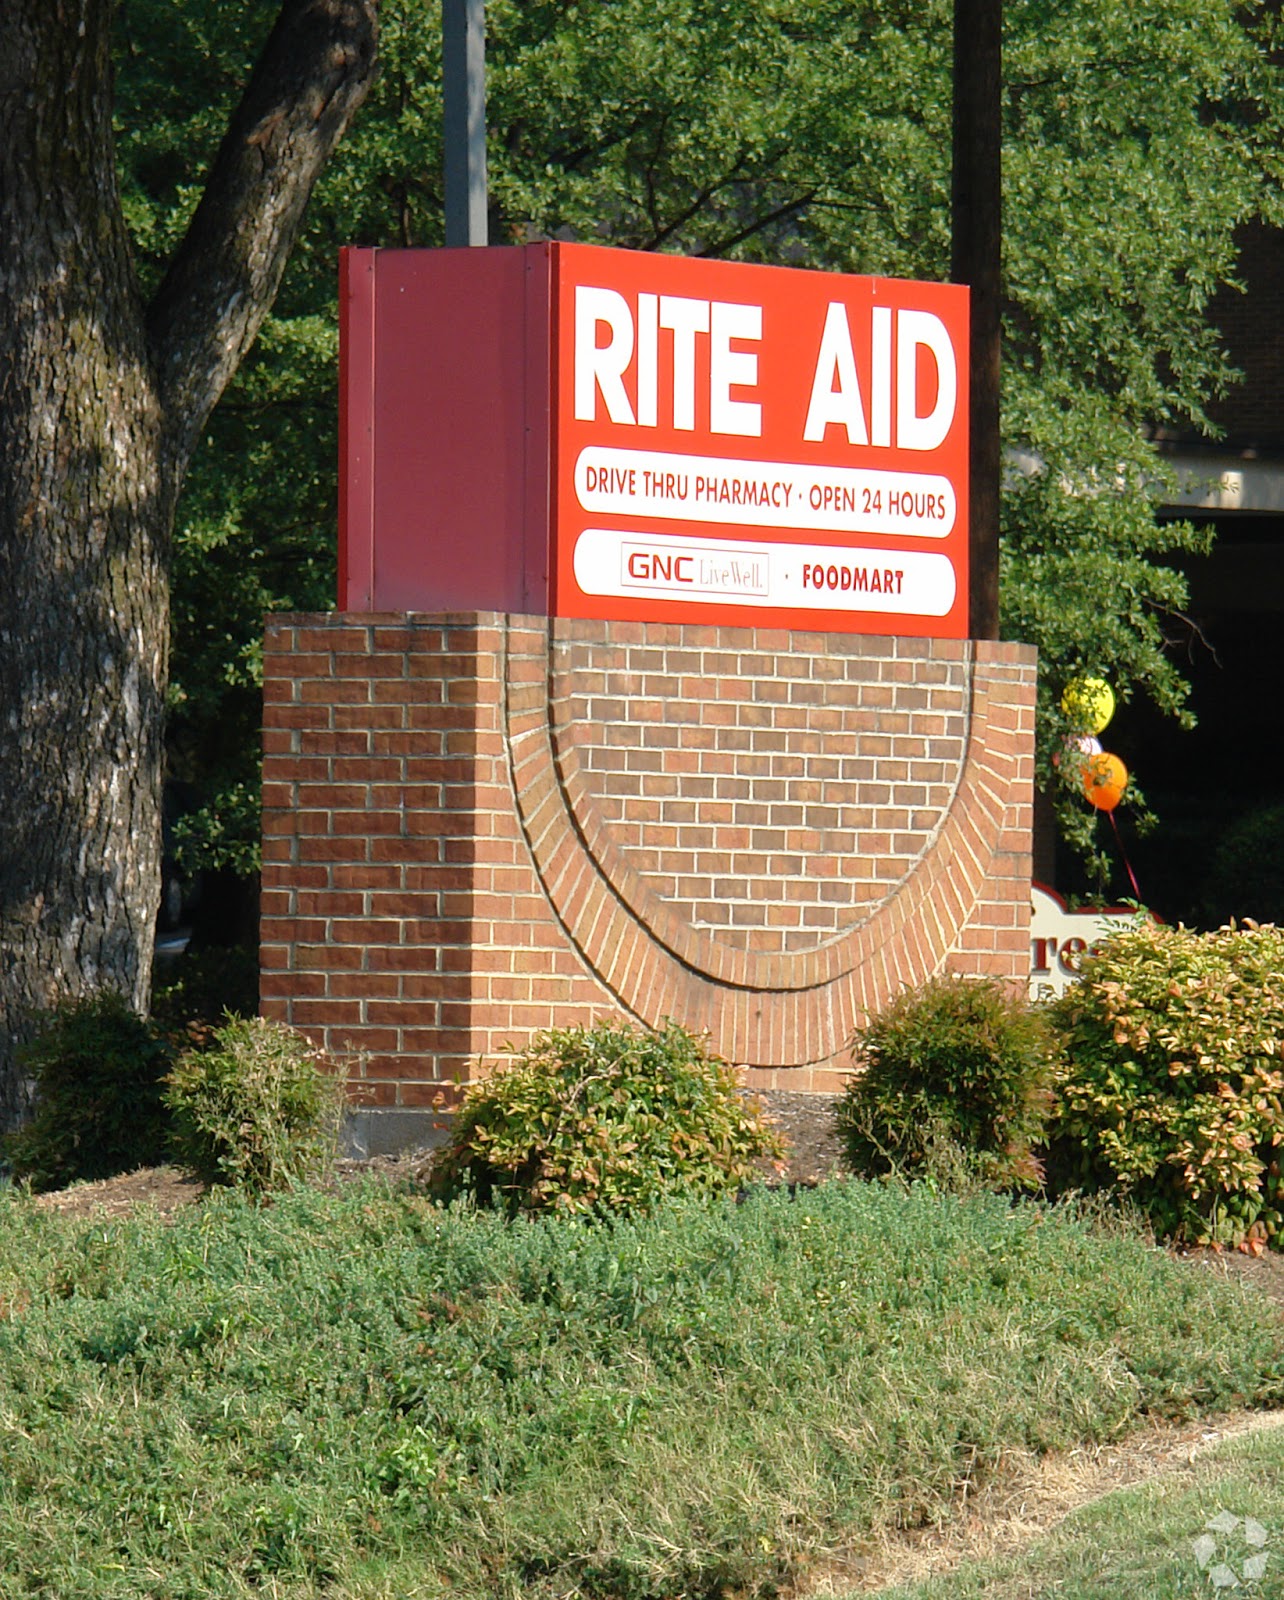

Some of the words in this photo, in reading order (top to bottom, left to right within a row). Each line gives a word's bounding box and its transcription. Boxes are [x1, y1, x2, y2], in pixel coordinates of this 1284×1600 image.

[574, 285, 763, 438] RITE
[803, 301, 957, 452] AID
[586, 466, 636, 496] DRIVE
[642, 471, 689, 501] THRU
[695, 476, 793, 508] PHARMACY
[809, 484, 855, 513] OPEN
[862, 487, 882, 514] 24
[888, 490, 946, 520] HOURS
[627, 553, 694, 583] GNC
[802, 563, 904, 595] FOODMART
